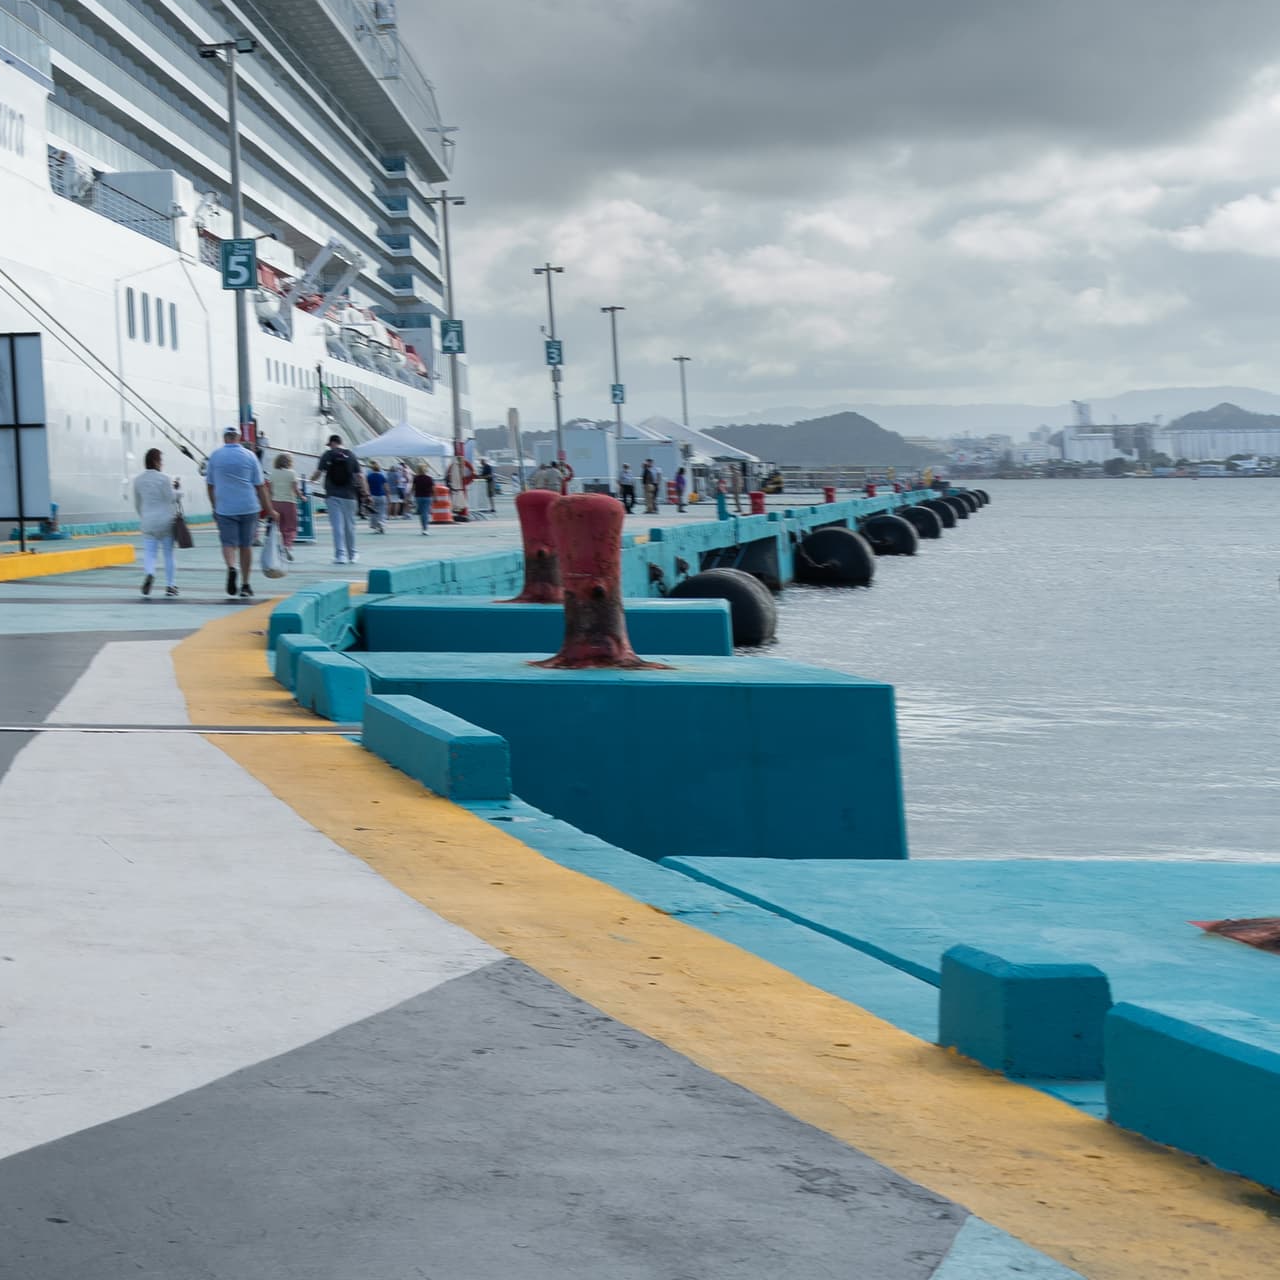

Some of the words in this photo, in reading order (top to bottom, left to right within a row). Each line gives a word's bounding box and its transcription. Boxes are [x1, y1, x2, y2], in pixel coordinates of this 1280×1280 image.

[227, 255, 250, 285] 5
[443, 331, 460, 350] 4
[549, 348, 560, 363] 3
[613, 390, 623, 403] 2
